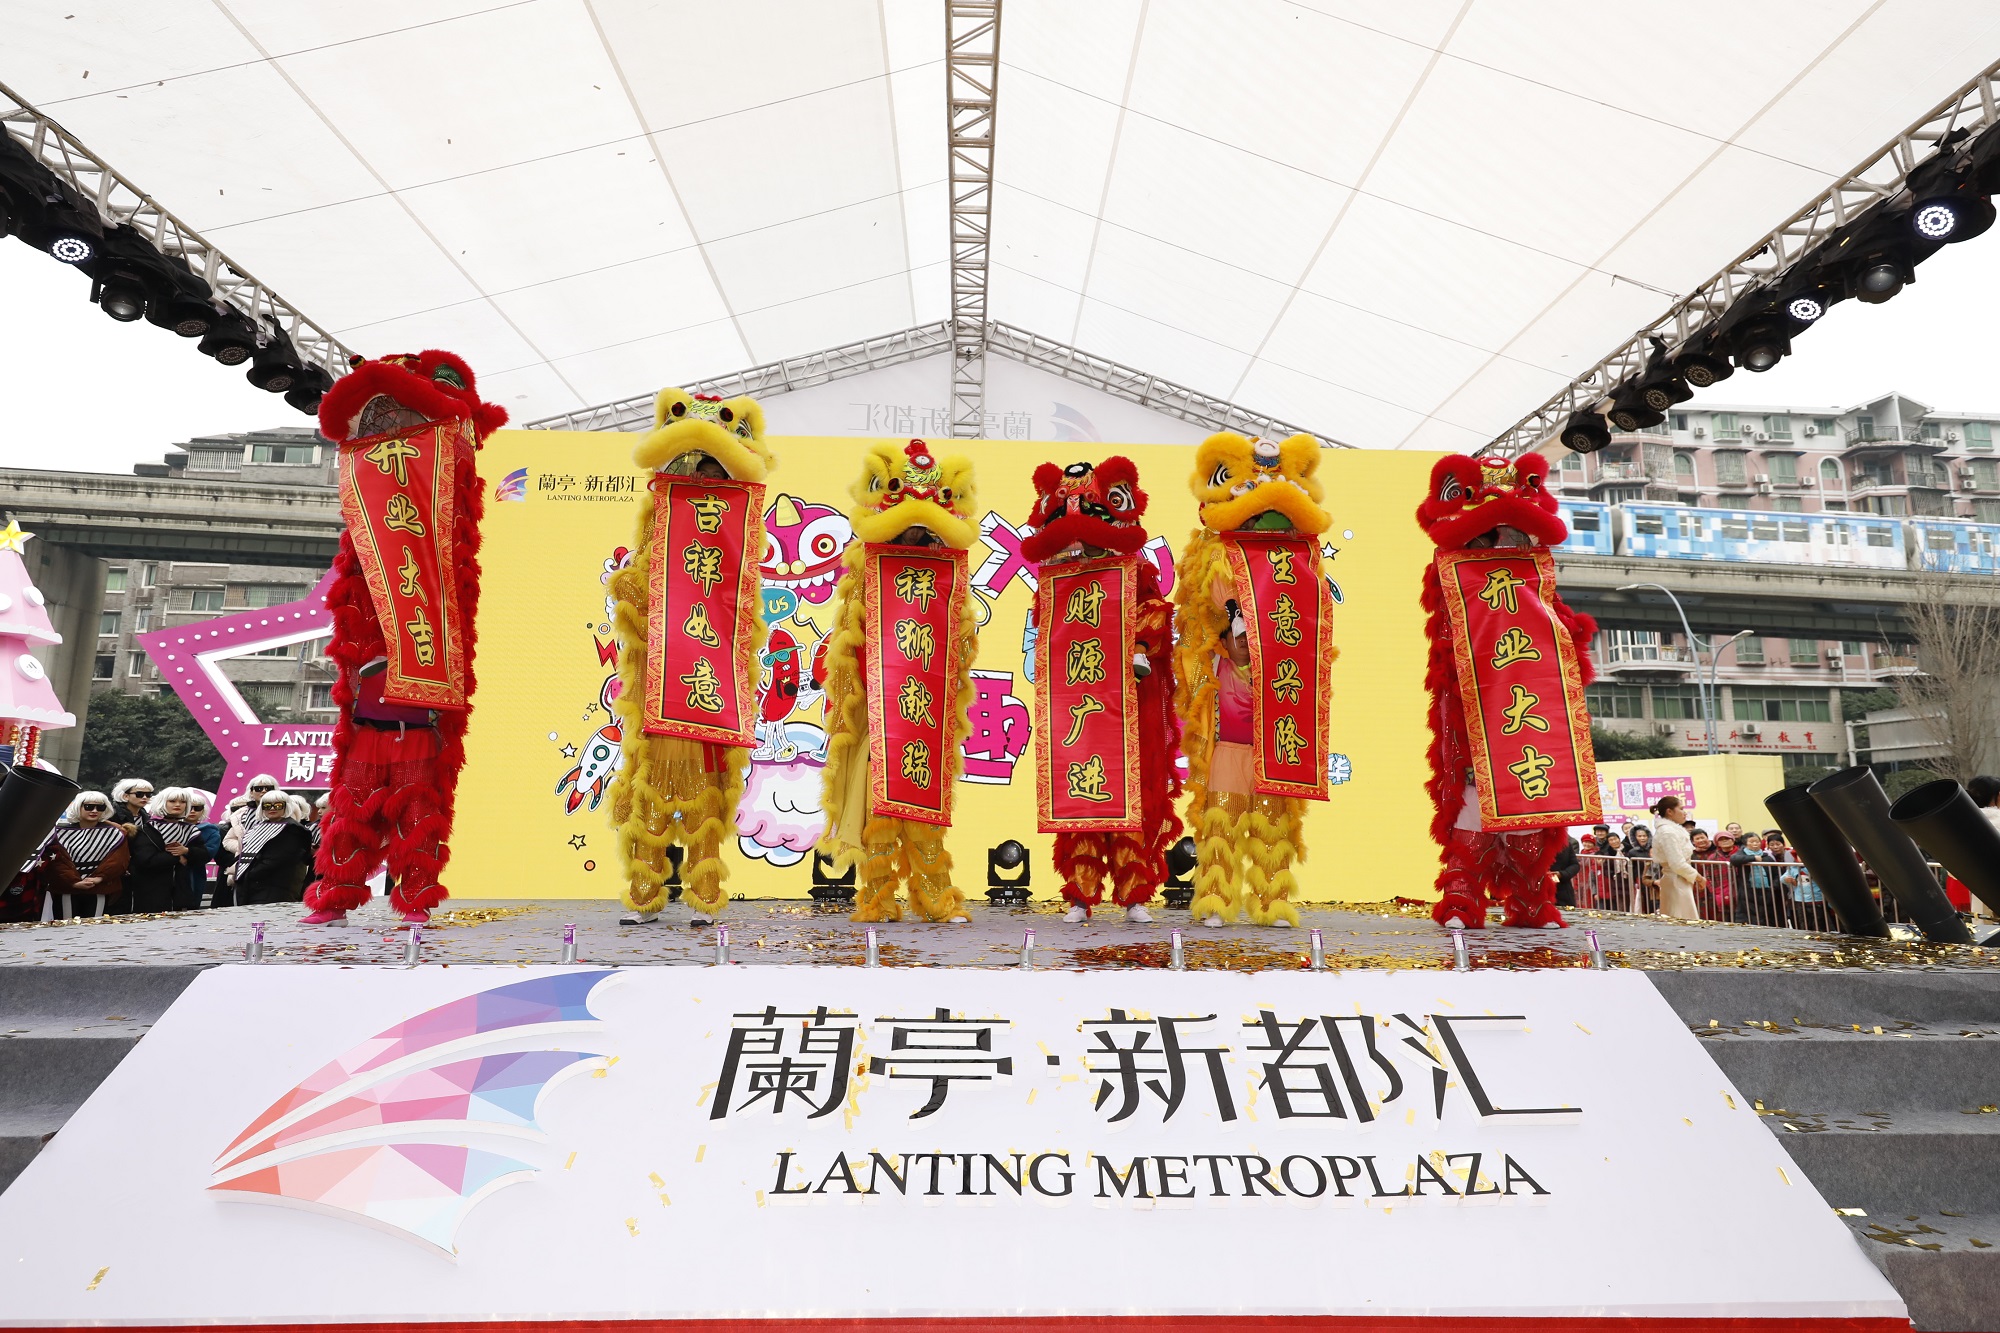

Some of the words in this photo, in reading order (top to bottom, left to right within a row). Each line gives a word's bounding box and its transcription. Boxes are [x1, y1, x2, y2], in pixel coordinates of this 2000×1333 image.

[364, 438, 436, 667] 开业大吉
[538, 474, 645, 493] 蘭亭·新都汇
[547, 494, 582, 502] LANTING
[583, 495, 635, 503] METROPLAZA
[679, 493, 730, 713] 吉祥如意
[894, 566, 937, 789] 祥狮献瑞
[1062, 580, 1113, 802] 财源广进
[1267, 545, 1308, 765] 生意兴隆
[1479, 567, 1556, 800] 开业大吉
[709, 1006, 1582, 1123] 蘭亭·新都汇
[769, 1152, 1076, 1196] LANTING
[1092, 1153, 1551, 1198] METROPLAZA
